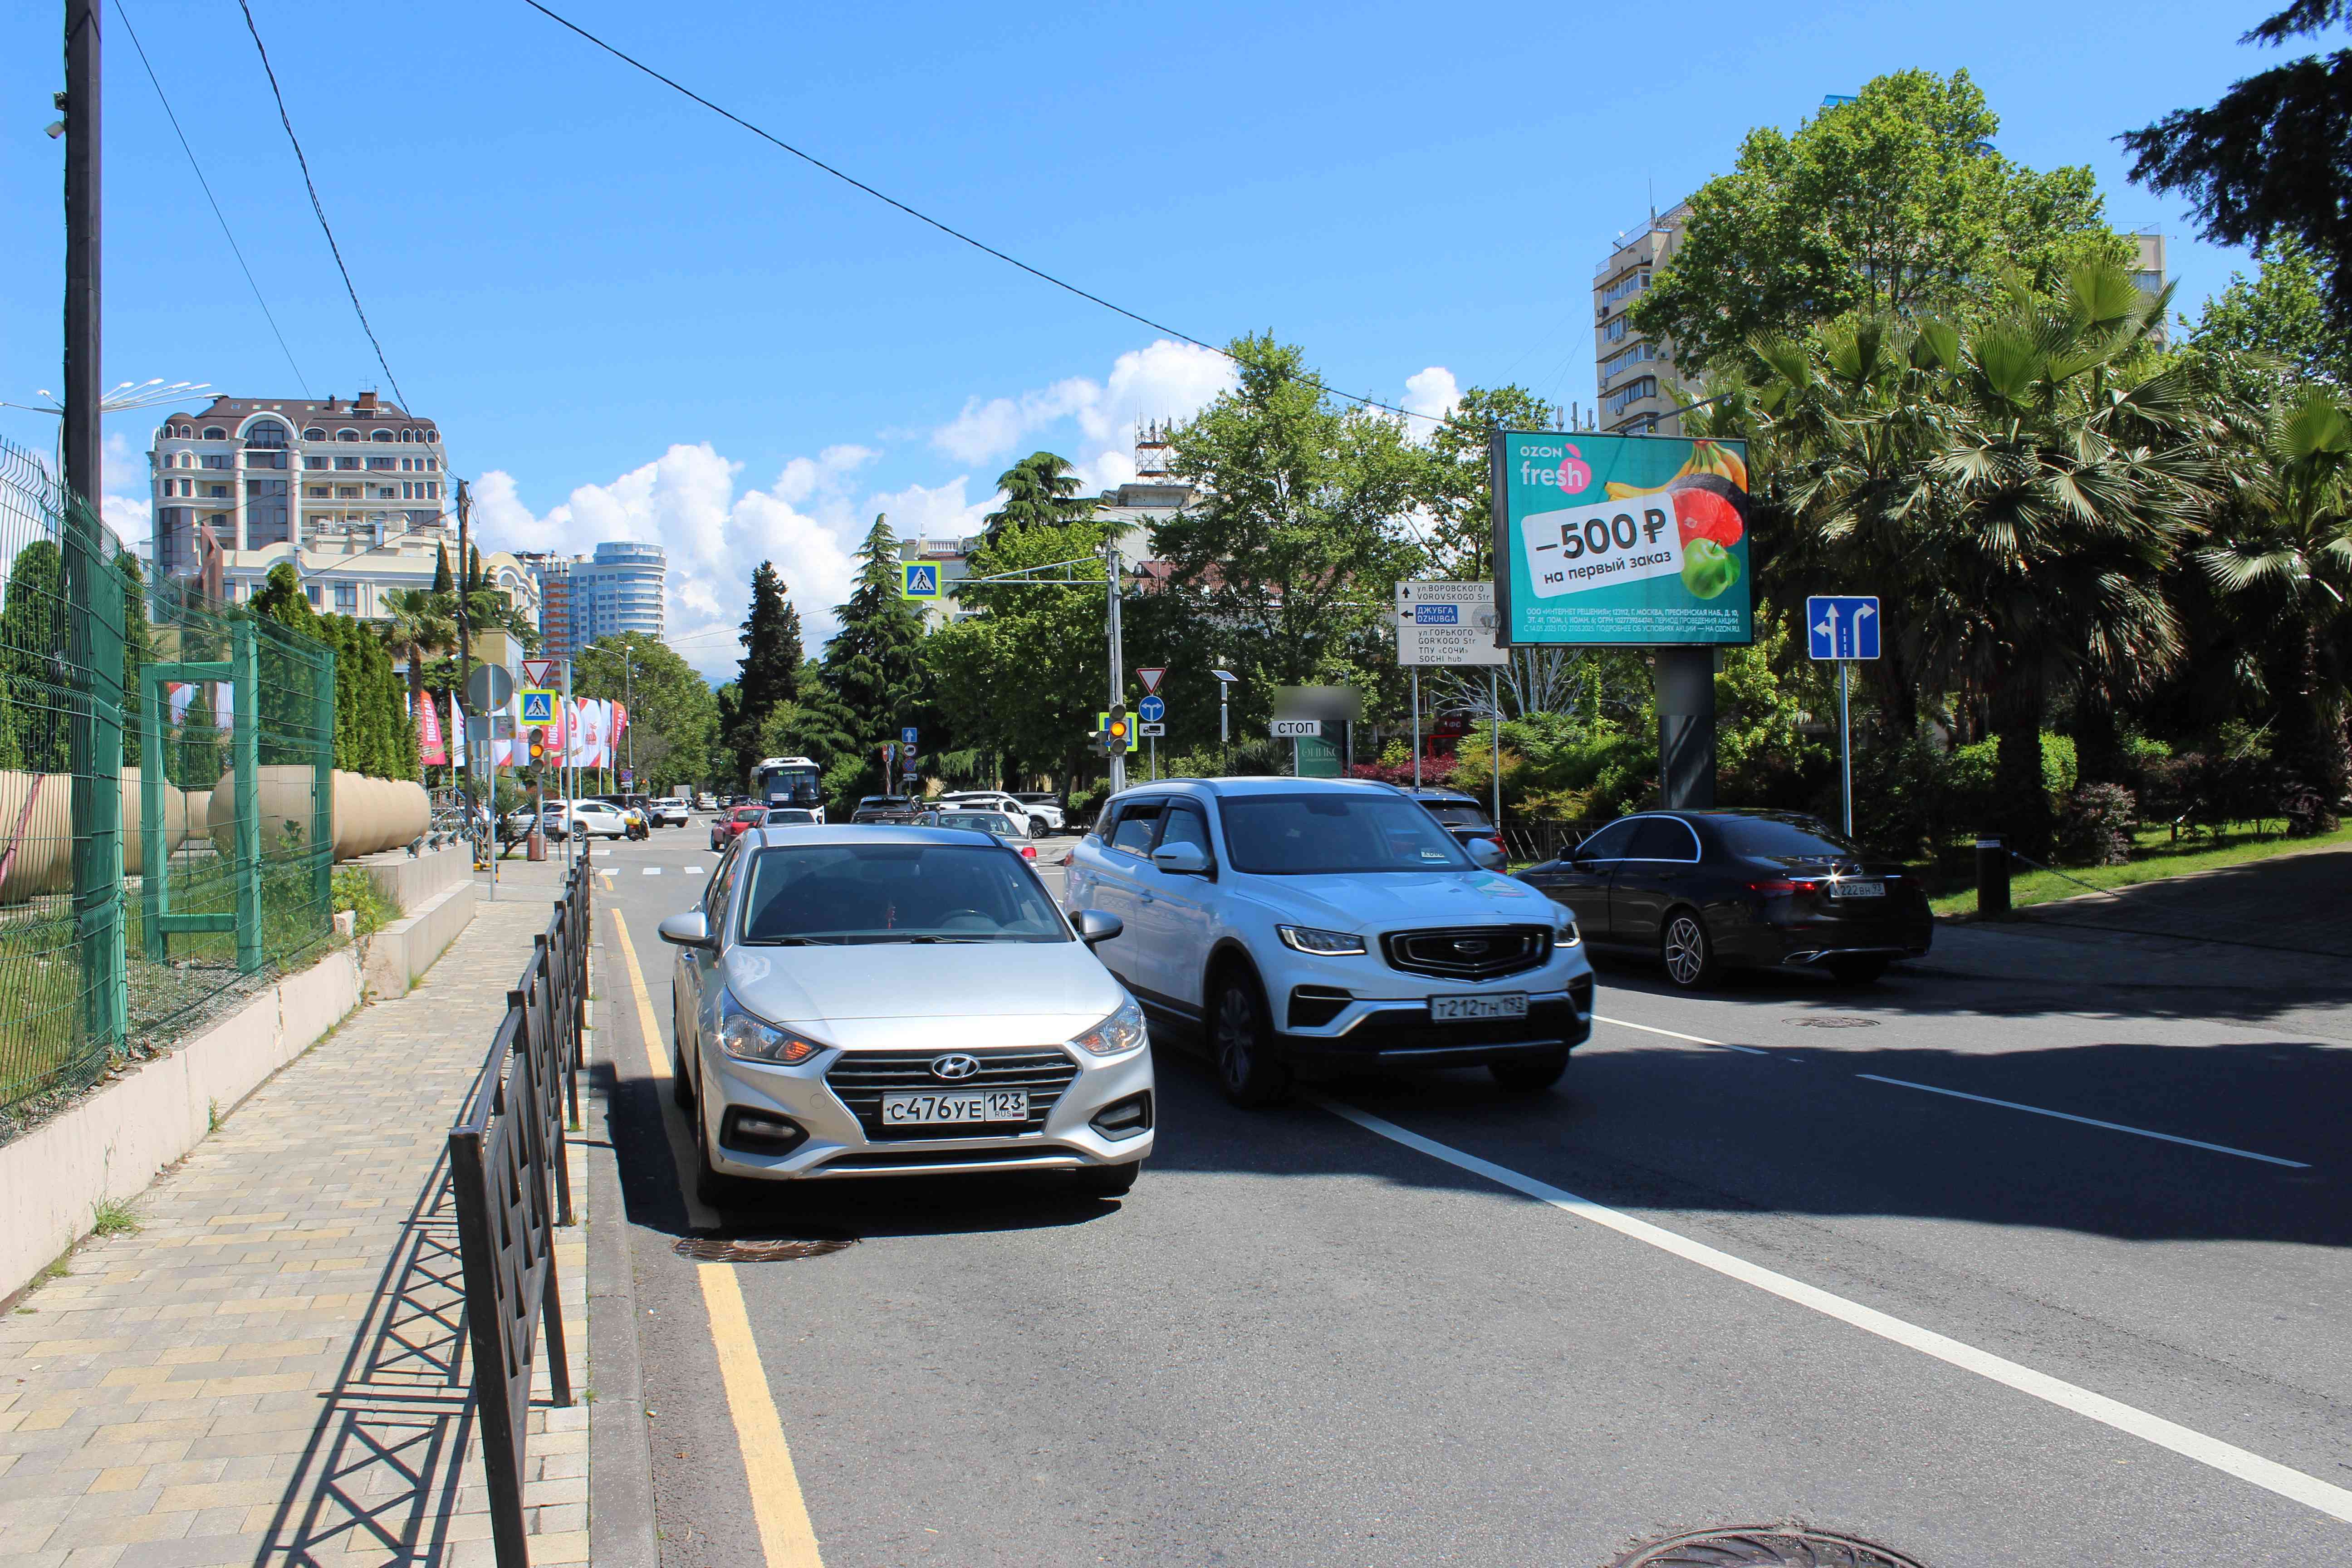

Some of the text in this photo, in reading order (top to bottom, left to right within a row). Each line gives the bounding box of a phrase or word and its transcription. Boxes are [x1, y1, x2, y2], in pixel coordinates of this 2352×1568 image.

[1520, 446, 1562, 457] OZON
[1520, 461, 1583, 486] fresh
[1643, 509, 1666, 544] ₽
[1544, 551, 1671, 584] на первый заказ
[1718, 617, 1739, 625] АКЦИИ
[1278, 722, 1313, 733] СТОП
[891, 1093, 1022, 1120] С476УЕ 123
